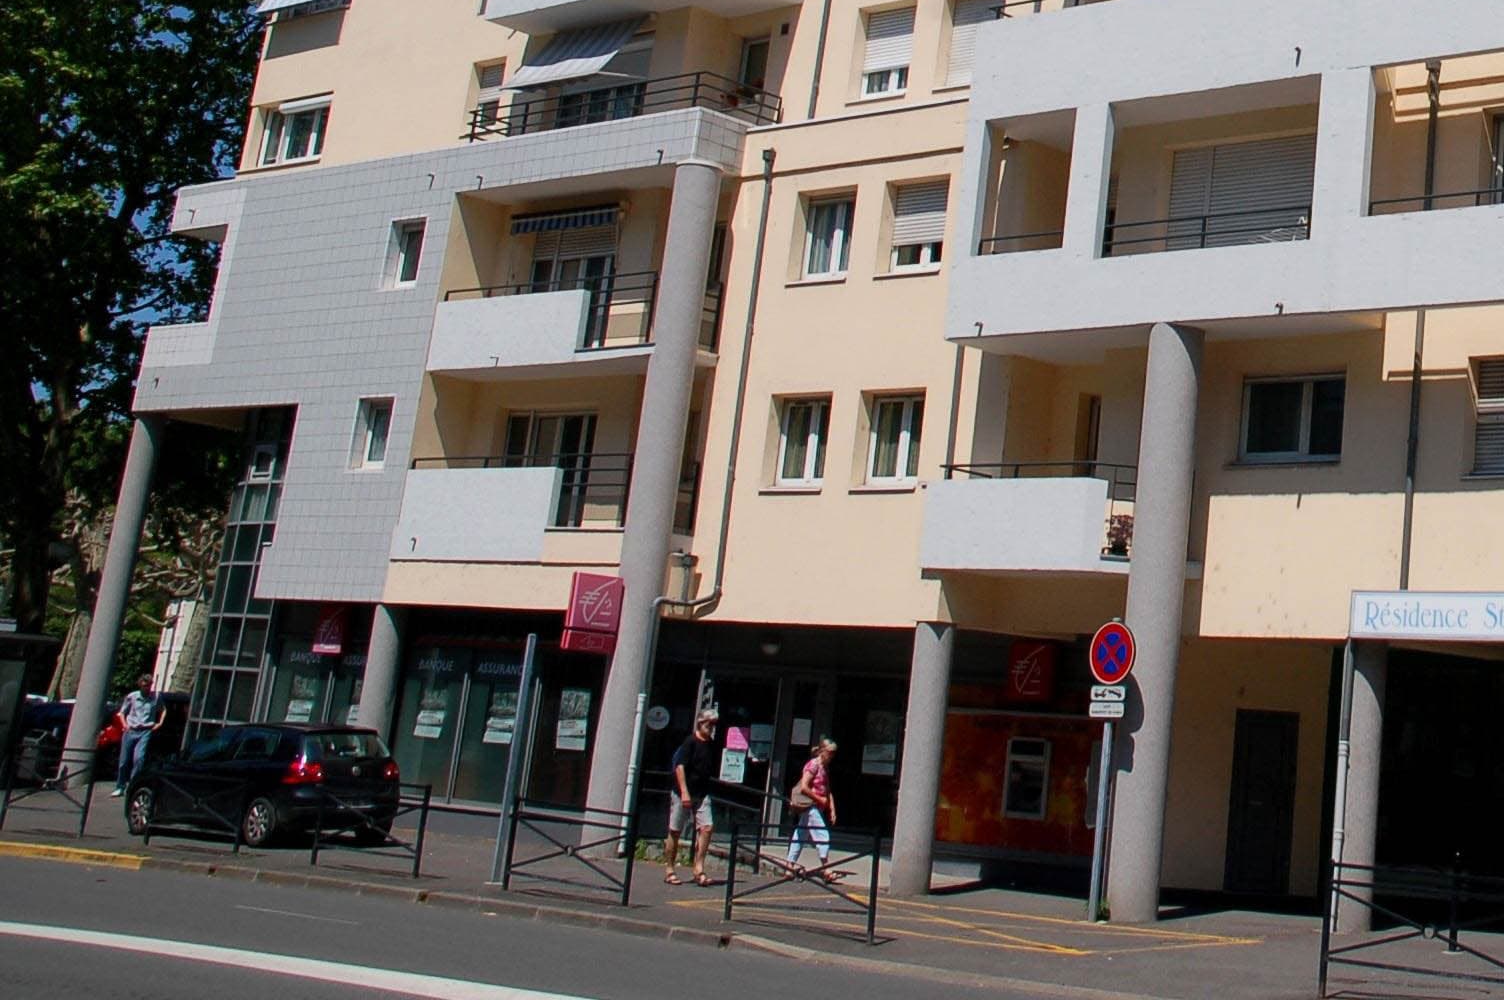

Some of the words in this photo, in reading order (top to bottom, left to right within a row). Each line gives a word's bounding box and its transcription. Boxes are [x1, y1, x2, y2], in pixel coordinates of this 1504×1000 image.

[1364, 601, 1468, 630] Résidence
[1483, 602, 1504, 628] St
[417, 657, 454, 673] BANQUE
[478, 661, 525, 677] ASSURANC
